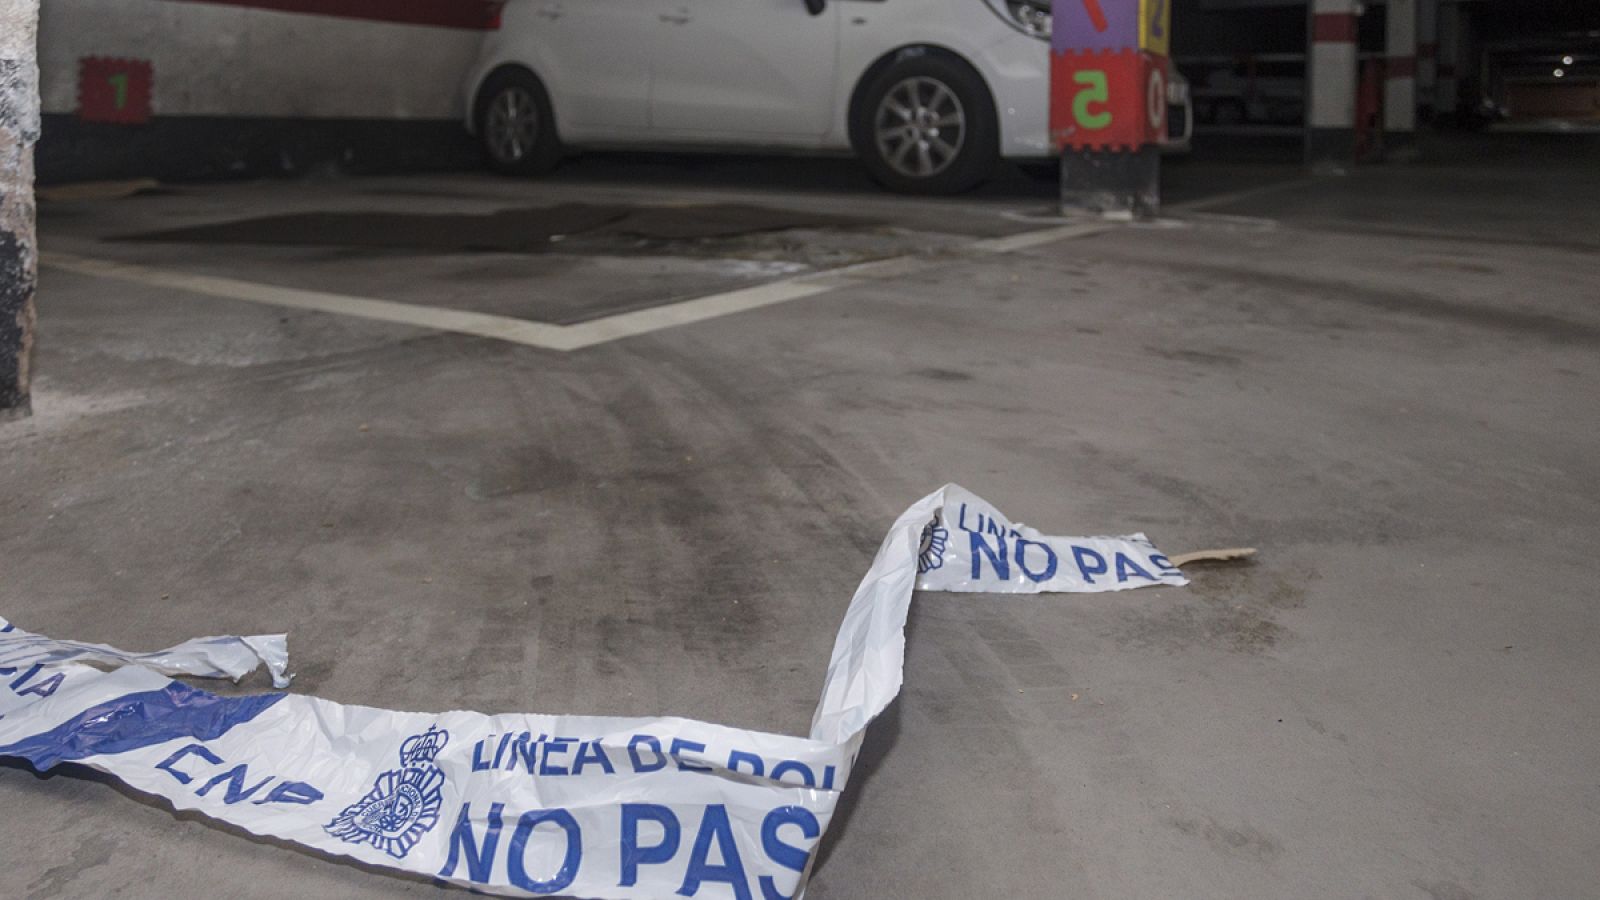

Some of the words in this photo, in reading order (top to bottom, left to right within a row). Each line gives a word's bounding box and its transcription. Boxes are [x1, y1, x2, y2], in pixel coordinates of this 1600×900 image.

[107, 72, 128, 112] 1
[969, 532, 1057, 583] NO
[155, 743, 325, 805] CNP
[627, 734, 713, 773] DE
[438, 802, 582, 894] NO
[619, 803, 821, 900] PAS
